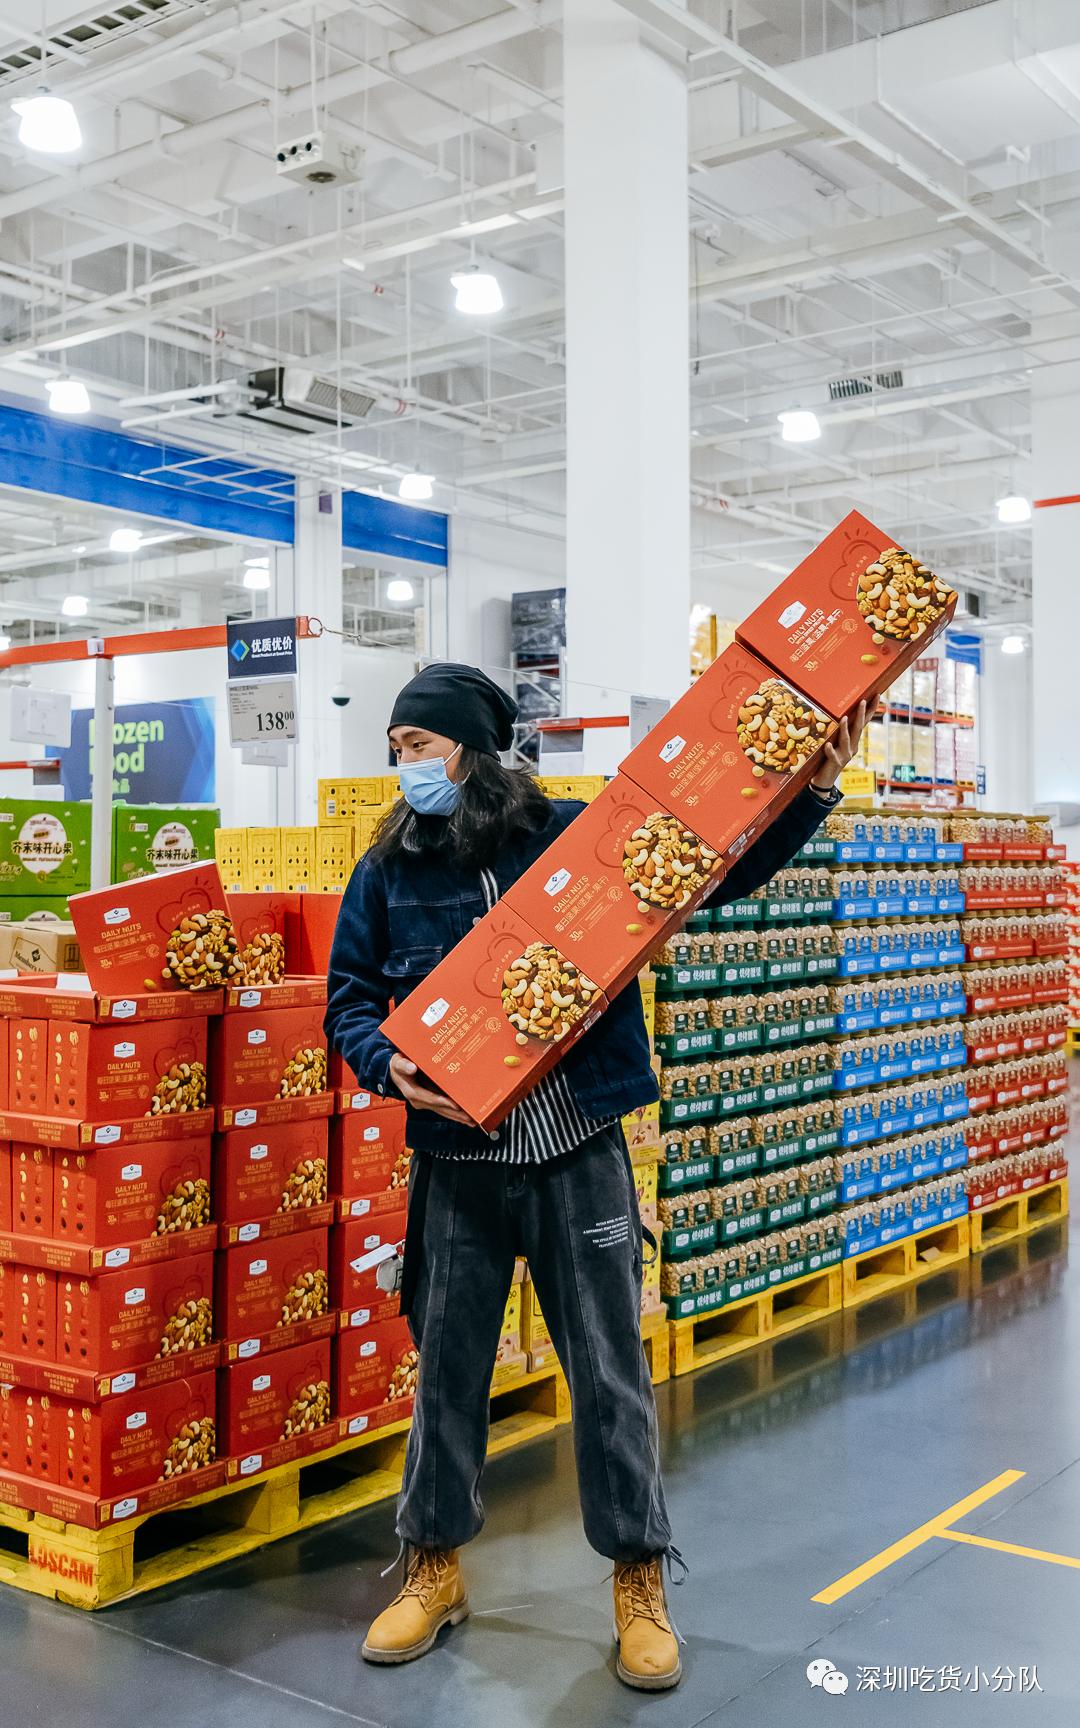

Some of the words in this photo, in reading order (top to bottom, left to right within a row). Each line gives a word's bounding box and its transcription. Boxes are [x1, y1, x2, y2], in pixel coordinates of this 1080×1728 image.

[788, 625, 806, 644] DAILY
[805, 608, 823, 626] NUTS
[251, 636, 292, 653] 优质优价
[668, 760, 687, 779] DAILY
[686, 742, 704, 760] NUTS
[12, 841, 73, 855] 芥末味开心果
[146, 848, 198, 860] 芥末味开心果
[553, 892, 572, 912] DAILY
[571, 876, 588, 893] NUTS
[102, 929, 121, 939] DAILY
[122, 923, 141, 933] NUTS
[431, 1024, 450, 1043] DAILY
[448, 1006, 467, 1024] NUTS
[107, 1063, 124, 1071] DAILY
[125, 1061, 140, 1069] NUTS
[115, 1185, 132, 1194] DAILY
[132, 1182, 148, 1191] NUTS
